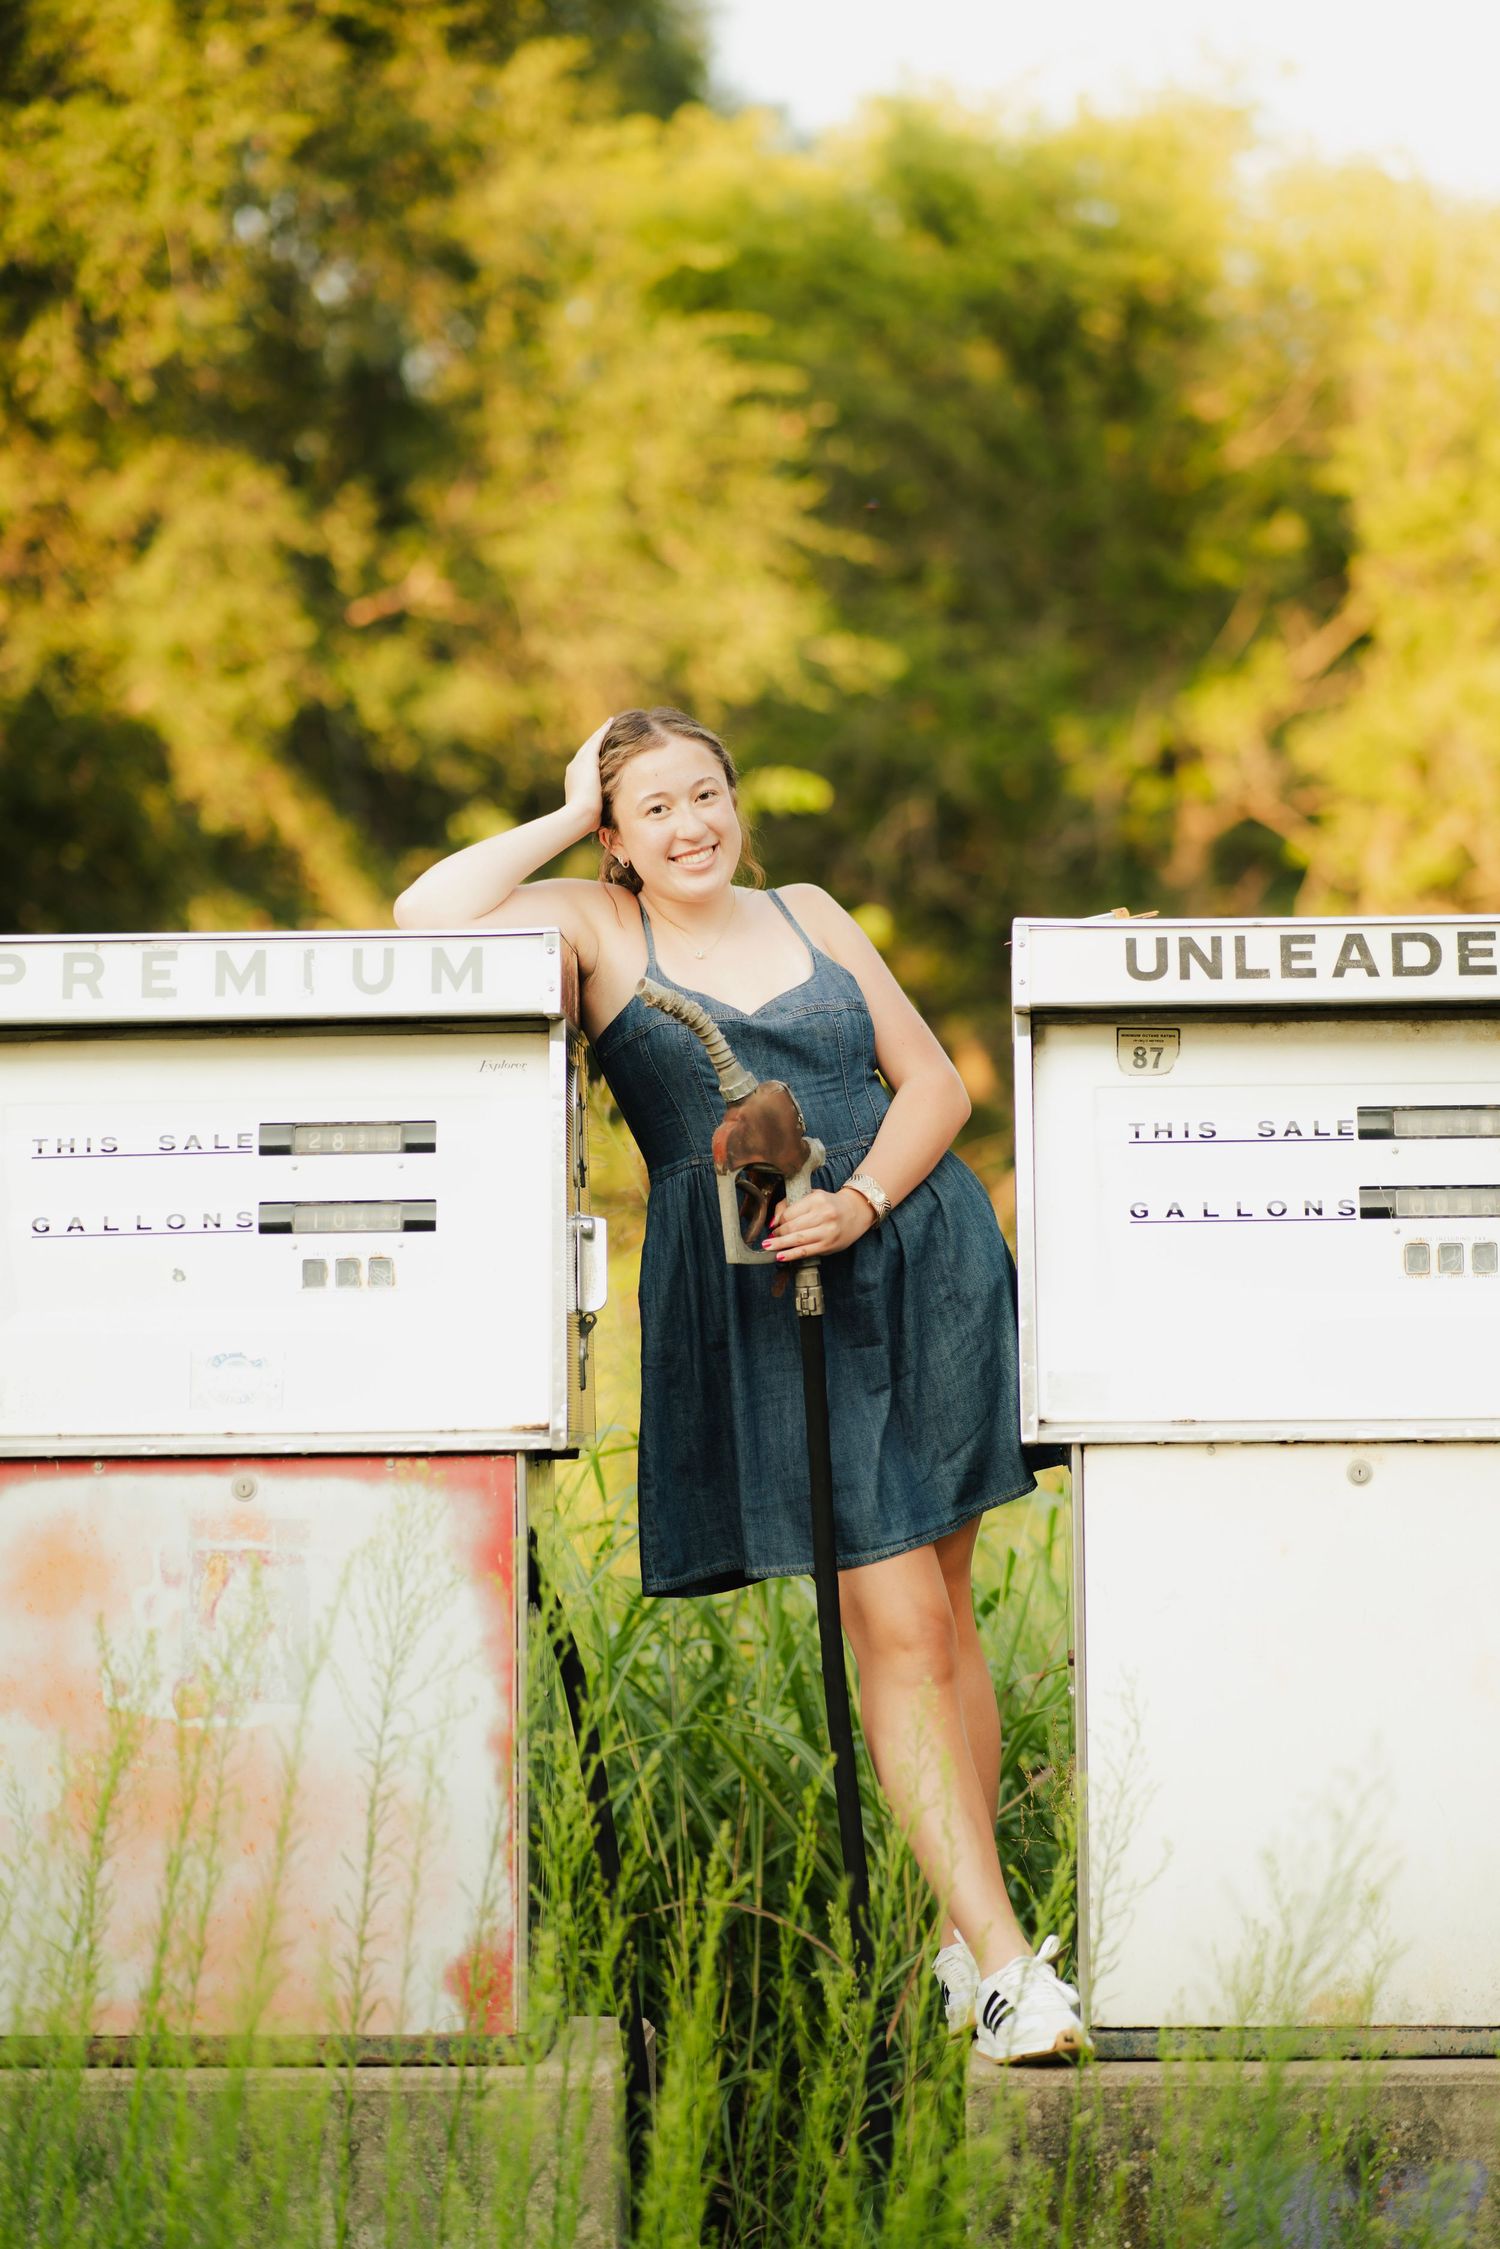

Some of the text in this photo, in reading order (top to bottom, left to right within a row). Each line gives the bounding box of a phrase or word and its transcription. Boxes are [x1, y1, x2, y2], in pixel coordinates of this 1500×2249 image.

[1125, 930, 1498, 981] UNLEADE
[1132, 1046, 1164, 1069] 87
[1128, 1119, 1354, 1139] THIS SALE
[32, 1132, 254, 1153] THIS SALE
[1129, 1199, 1356, 1219] GALLONS
[31, 1211, 254, 1232] GALLONS
